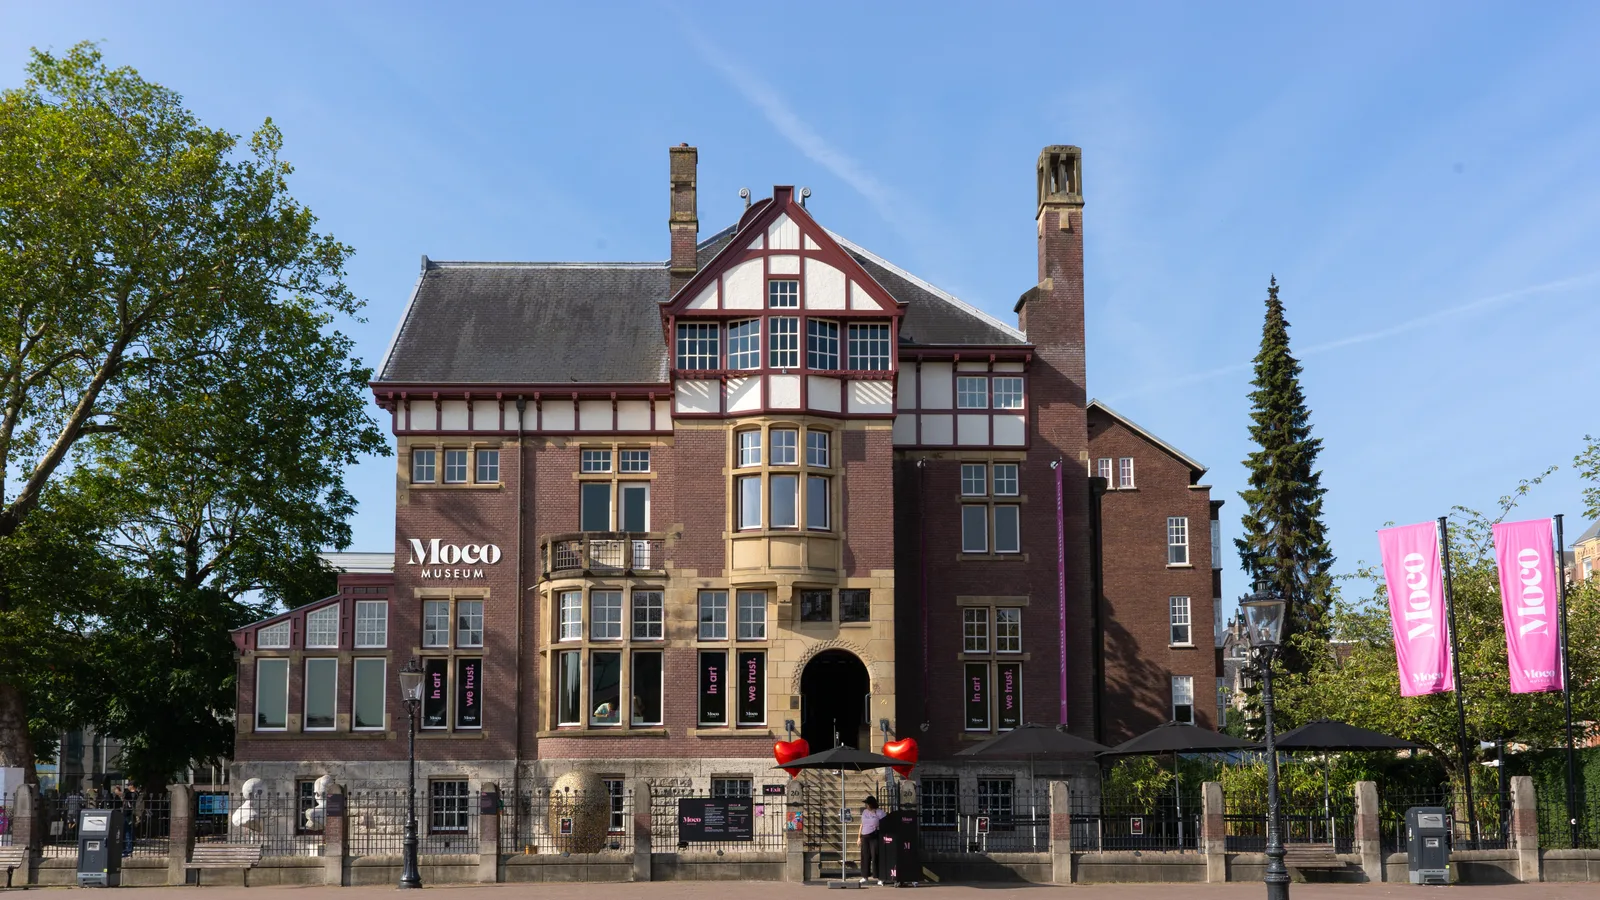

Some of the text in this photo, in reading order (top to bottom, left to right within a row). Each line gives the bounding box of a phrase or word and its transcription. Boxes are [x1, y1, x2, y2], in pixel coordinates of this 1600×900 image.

[406, 538, 501, 565] Moco
[421, 568, 484, 578] MUSEUM
[1403, 552, 1437, 643] Moco
[1517, 548, 1549, 640] Moco
[430, 672, 441, 699] In art
[465, 664, 475, 707] we trust.
[707, 666, 717, 694] In art
[747, 657, 757, 702] we trust.
[1412, 672, 1444, 683] Moco
[1524, 670, 1555, 678] Moco
[971, 676, 981, 702] In art
[1004, 669, 1013, 710] we trust.
